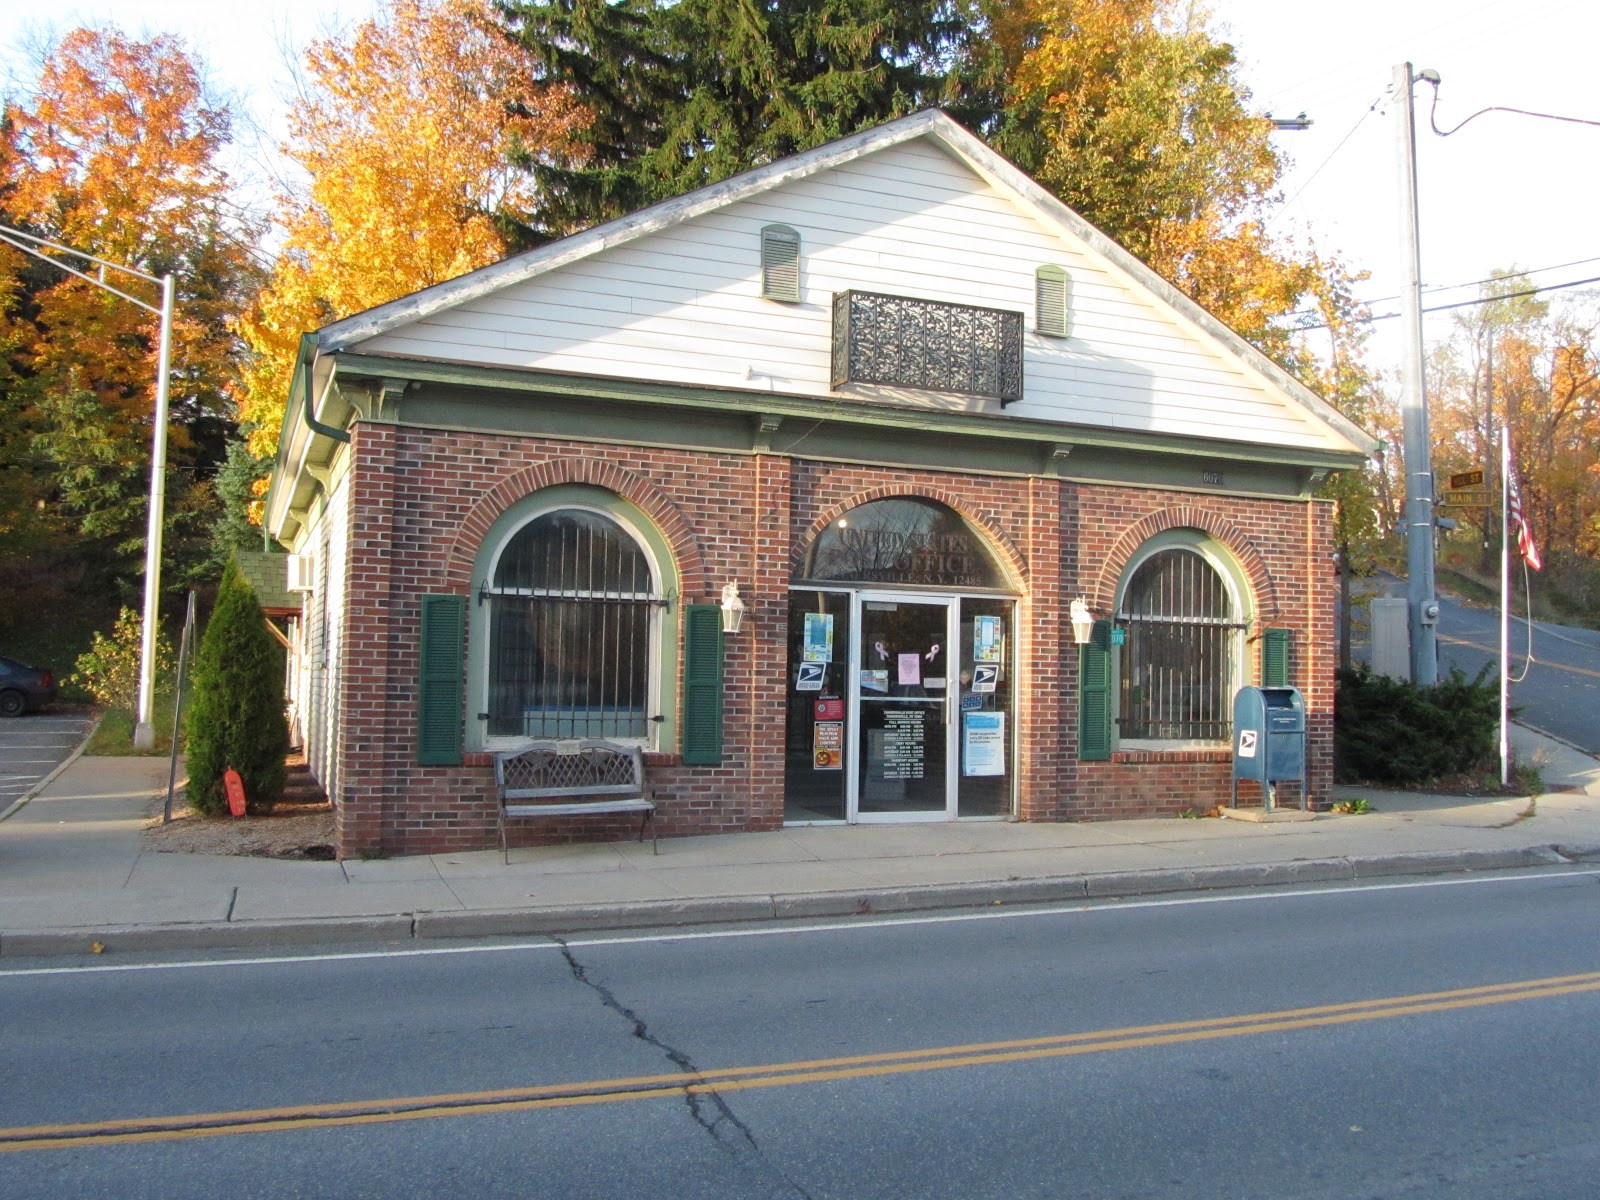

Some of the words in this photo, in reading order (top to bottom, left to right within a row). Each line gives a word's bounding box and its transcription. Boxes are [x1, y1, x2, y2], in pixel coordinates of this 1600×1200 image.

[1449, 494, 1472, 503] MAIN
[1477, 494, 1488, 503] ST
[894, 553, 976, 574] OFFICE
[954, 575, 982, 586] 12485
